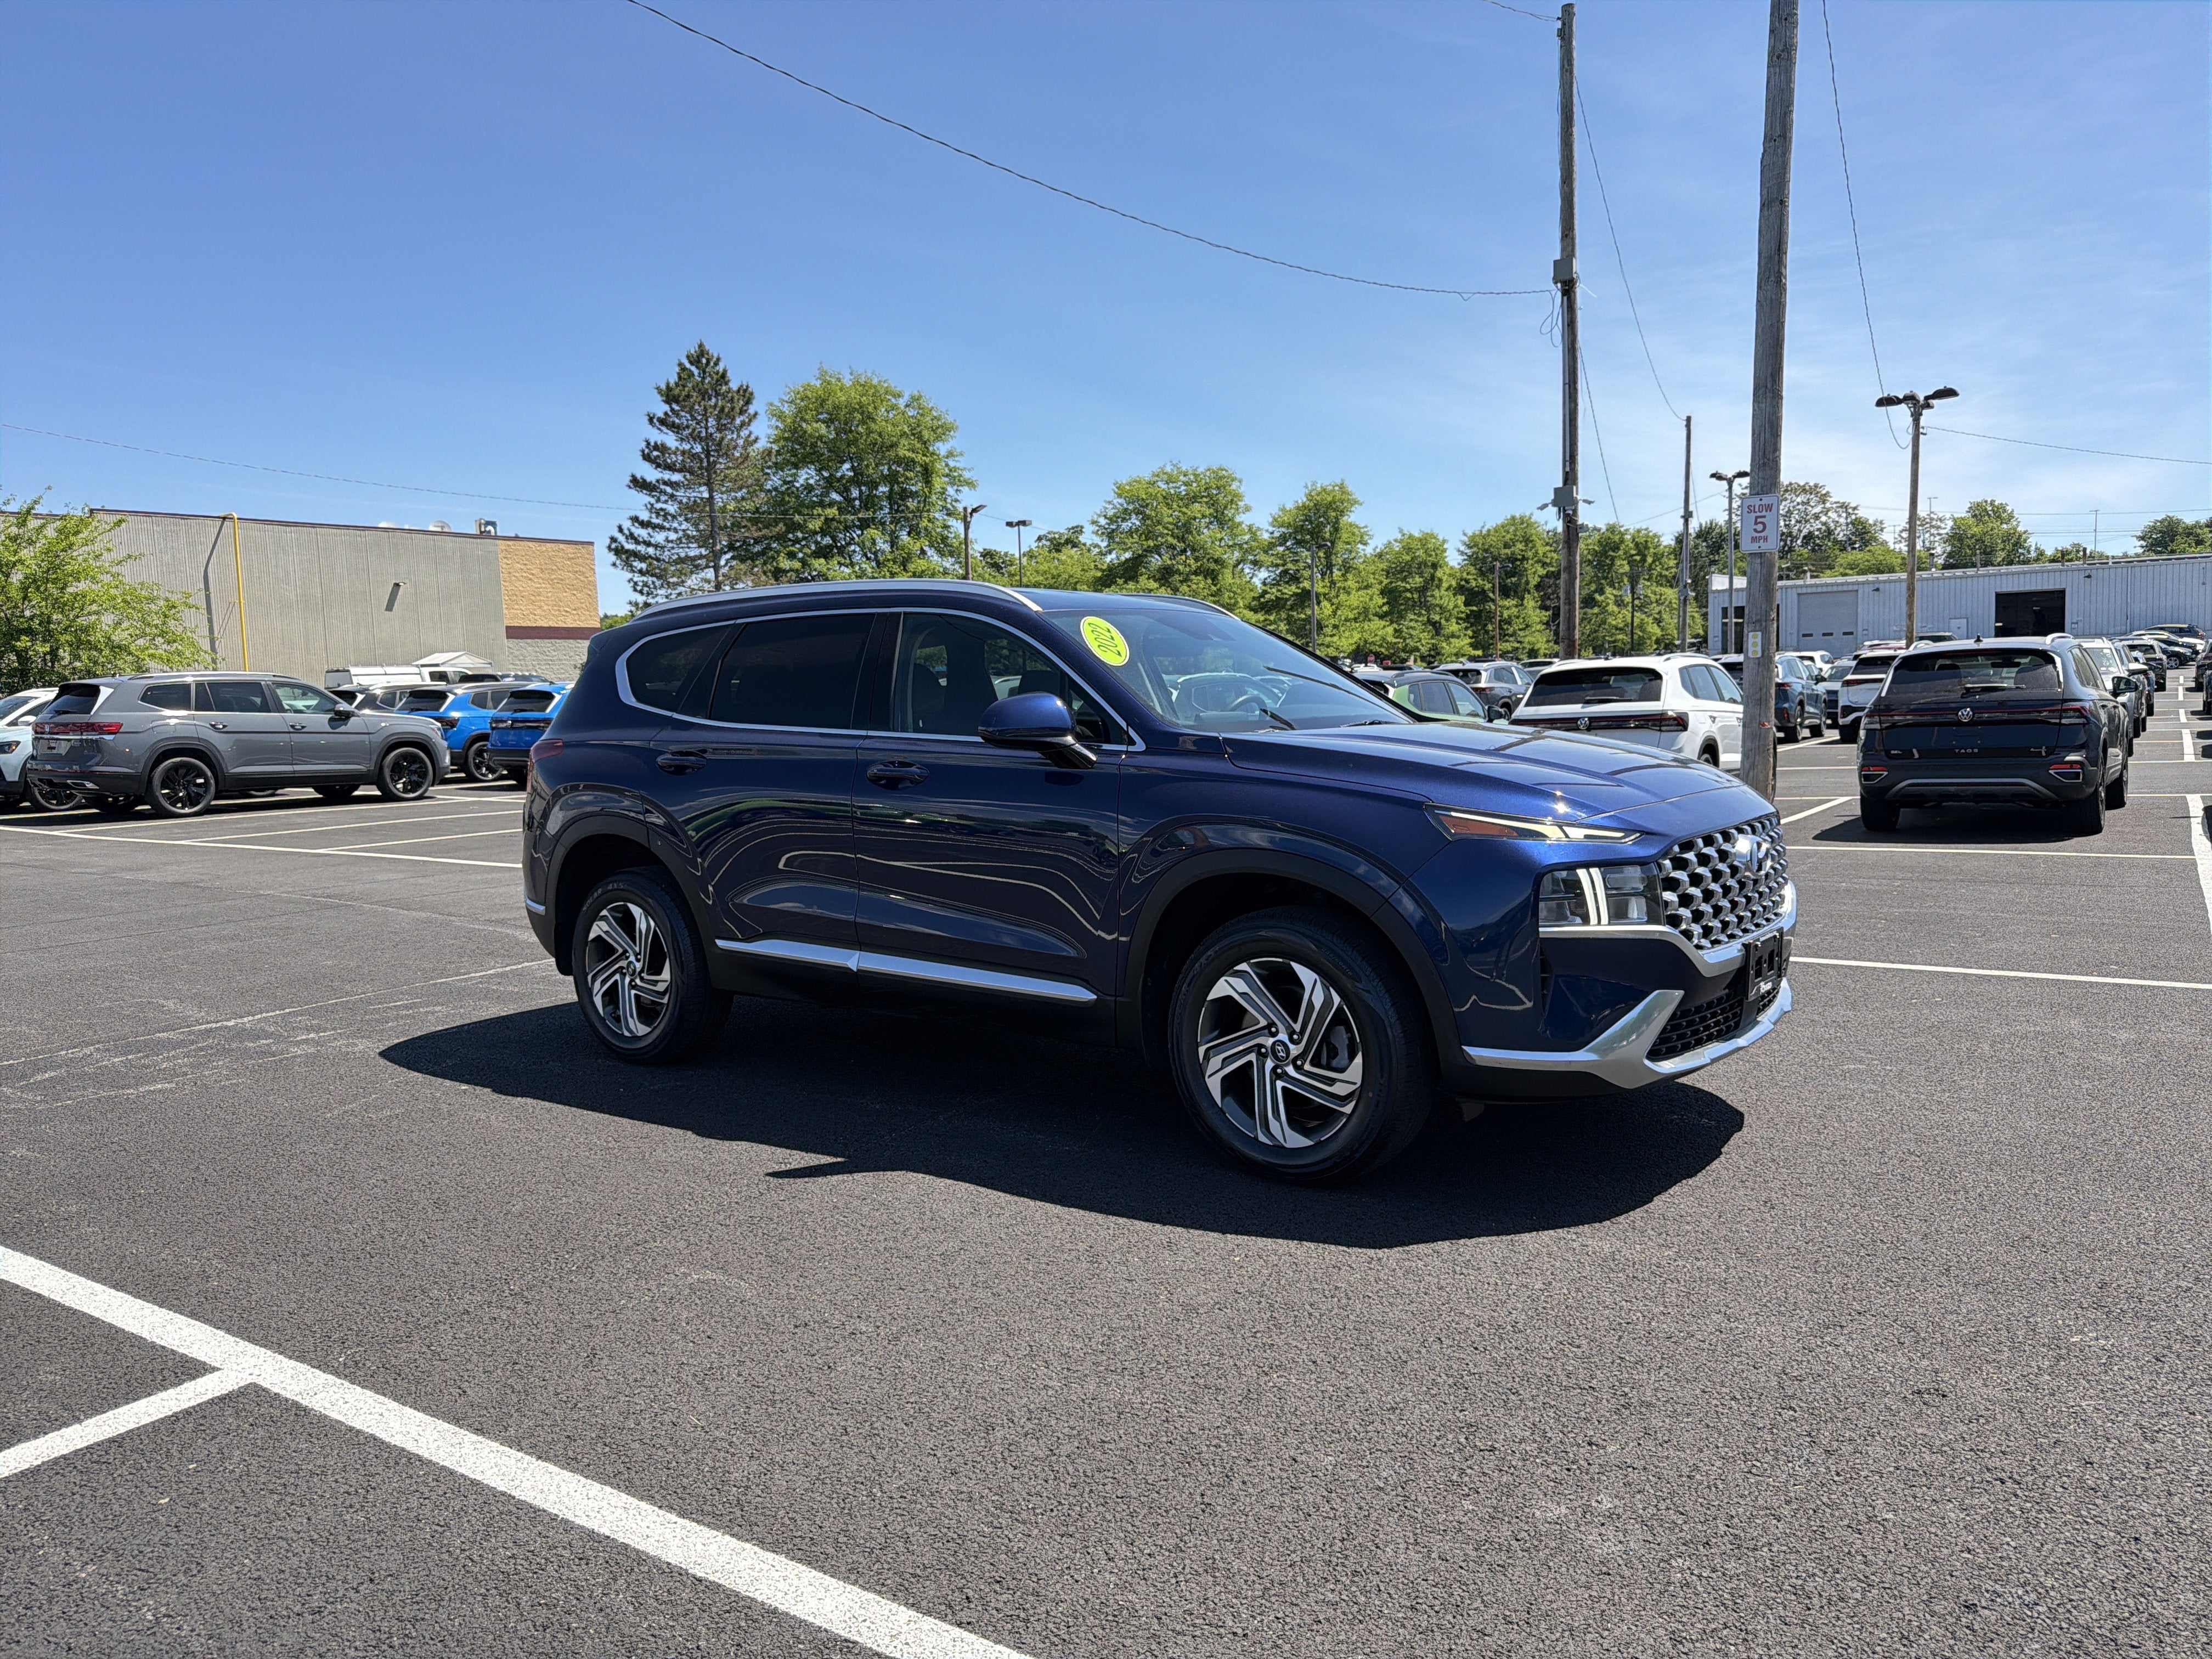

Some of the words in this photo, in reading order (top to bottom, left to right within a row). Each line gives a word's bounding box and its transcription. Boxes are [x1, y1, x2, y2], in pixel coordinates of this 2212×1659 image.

[1747, 504, 1773, 514] SLOW
[1753, 515, 1767, 534] 5
[1751, 535, 1768, 544] MPH
[1087, 622, 1122, 658] 2022
